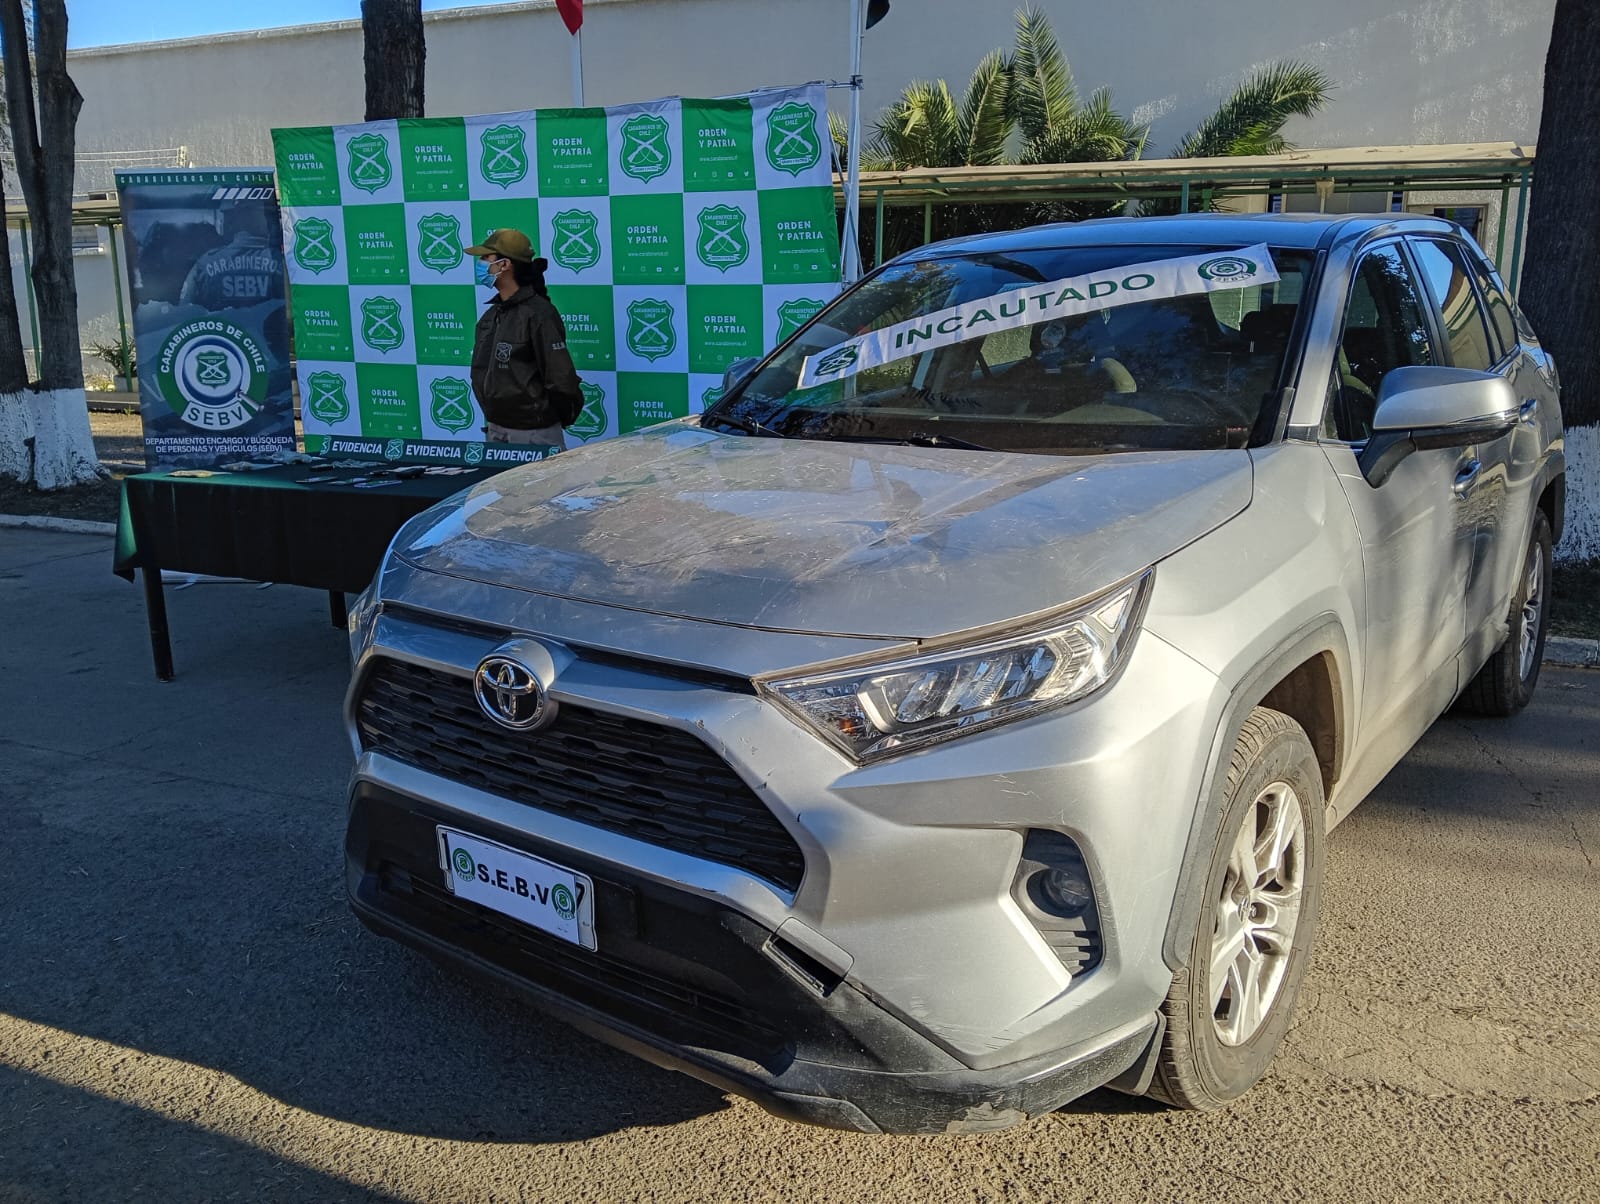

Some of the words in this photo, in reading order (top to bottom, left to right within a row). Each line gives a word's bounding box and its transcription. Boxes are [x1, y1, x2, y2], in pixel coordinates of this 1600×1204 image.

[698, 128, 727, 137] ORDEN
[552, 137, 583, 146] ORDEN
[699, 139, 705, 148] Y
[707, 138, 737, 147] PATRIA
[414, 145, 443, 153] ORDEN
[552, 148, 558, 156] Y
[560, 147, 592, 156] PATRIA
[288, 153, 315, 161] ORDEN
[415, 155, 421, 163] Y
[422, 154, 453, 163] PATRIA
[290, 162, 295, 170] Y
[297, 161, 324, 169] PATRIA
[627, 225, 658, 234] ORDEN
[777, 220, 812, 231] ORDEN
[358, 231, 385, 240] ORDEN
[627, 236, 633, 244] Y
[636, 235, 668, 244] PATRIA
[778, 232, 784, 241] Y
[787, 231, 824, 241] PATRIA
[360, 241, 365, 249] Y
[366, 240, 394, 249] PATRIA
[206, 255, 281, 277] CARABINERO
[222, 275, 269, 297] SEBV
[895, 274, 1155, 348] INCAUTADO
[427, 312, 455, 320] ORDEN
[560, 314, 590, 322] ORDEN
[703, 315, 737, 323] ORDEN
[312, 318, 339, 327] PATRIA
[427, 321, 433, 329] Y
[434, 321, 464, 329] PATRIA
[568, 323, 600, 332] PATRIA
[704, 325, 710, 333] Y
[712, 325, 747, 333] PATRIA
[160, 321, 224, 373] CARABINEROS
[226, 325, 244, 340] DE
[243, 338, 265, 373] CHILE
[371, 389, 398, 397] ORDEN
[379, 398, 407, 406] PATRIA
[633, 400, 664, 409] ORDEN
[187, 406, 244, 426] SEBV
[633, 410, 639, 418] Y
[641, 410, 673, 419] PATRIA
[145, 437, 206, 446] DEPARTAMENTO
[206, 436, 244, 445] ENCARGO
[155, 445, 167, 453] DE
[167, 445, 208, 453] PERSONAS
[332, 441, 383, 454] EVIDENCIA
[405, 444, 461, 458] EVIDENCIA
[485, 448, 543, 462] EVIDENCIA
[477, 863, 550, 905] S.E.B.V
